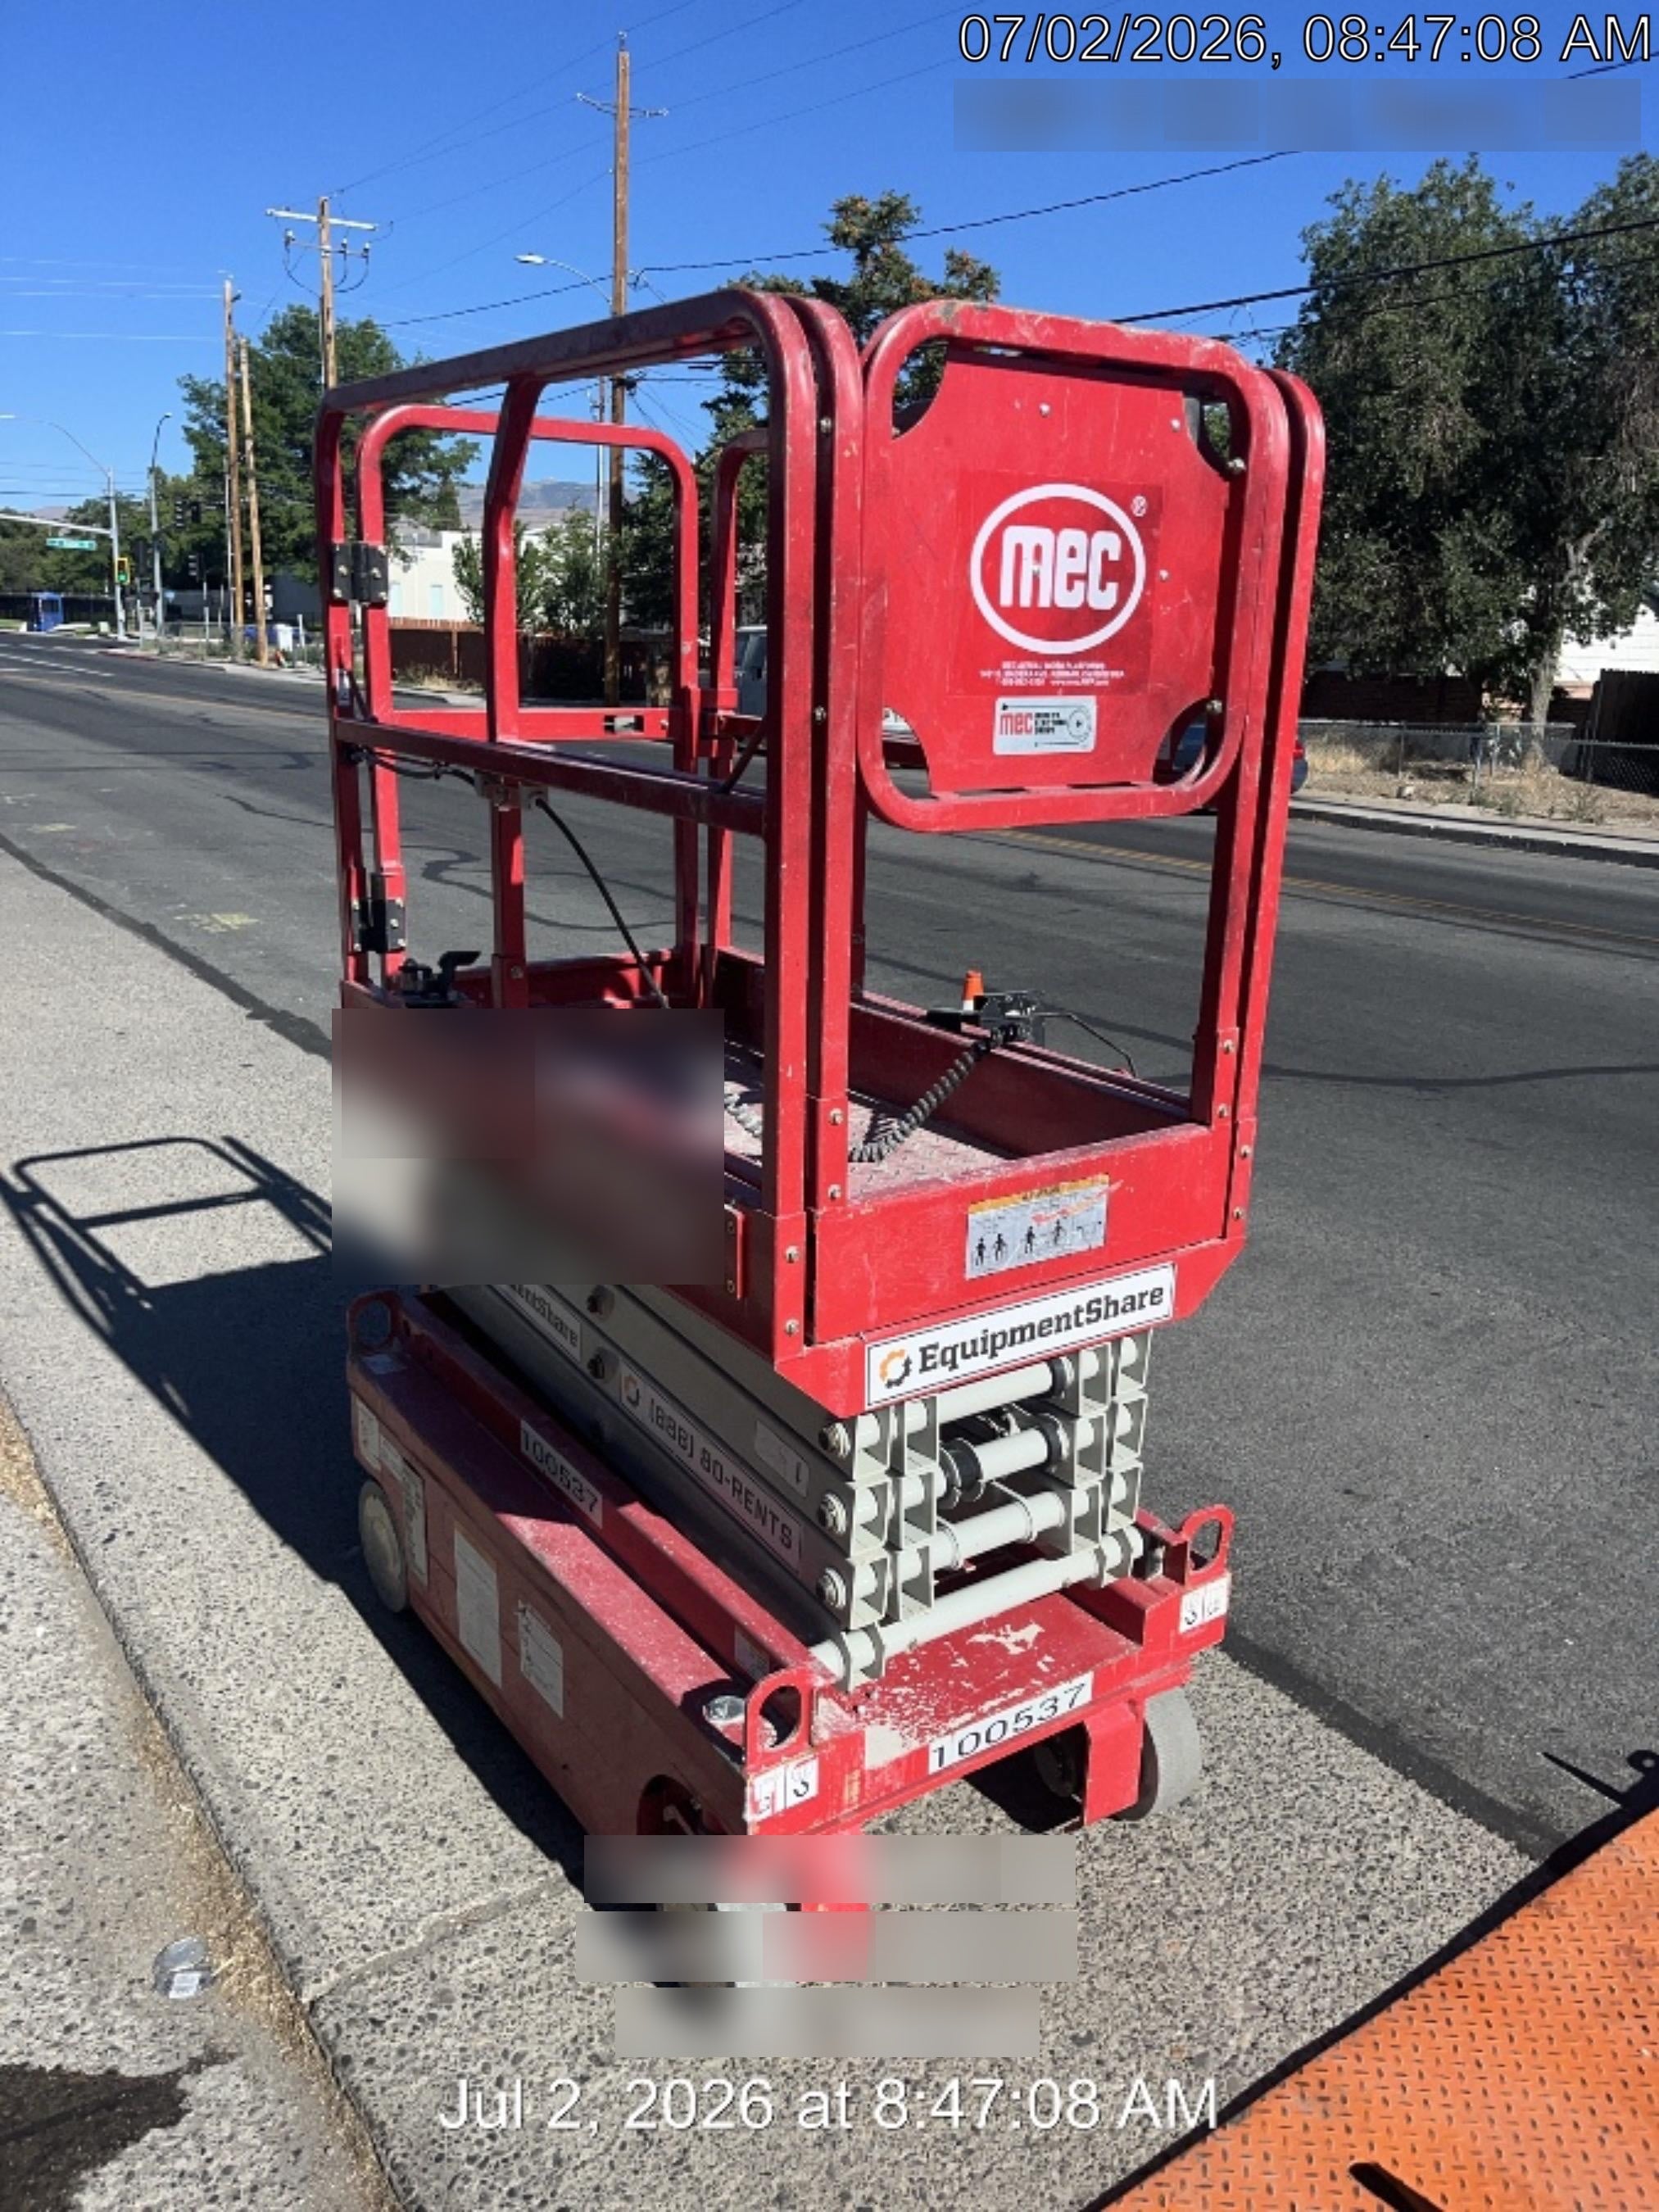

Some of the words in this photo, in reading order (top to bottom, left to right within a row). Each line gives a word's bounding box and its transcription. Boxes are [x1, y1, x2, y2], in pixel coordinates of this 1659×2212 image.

[918, 1285, 1164, 1374] EquipmentShare
[523, 1431, 599, 1515] 100537
[700, 1448, 793, 1549] 80-RENTS
[931, 1684, 1086, 1769] 100537
